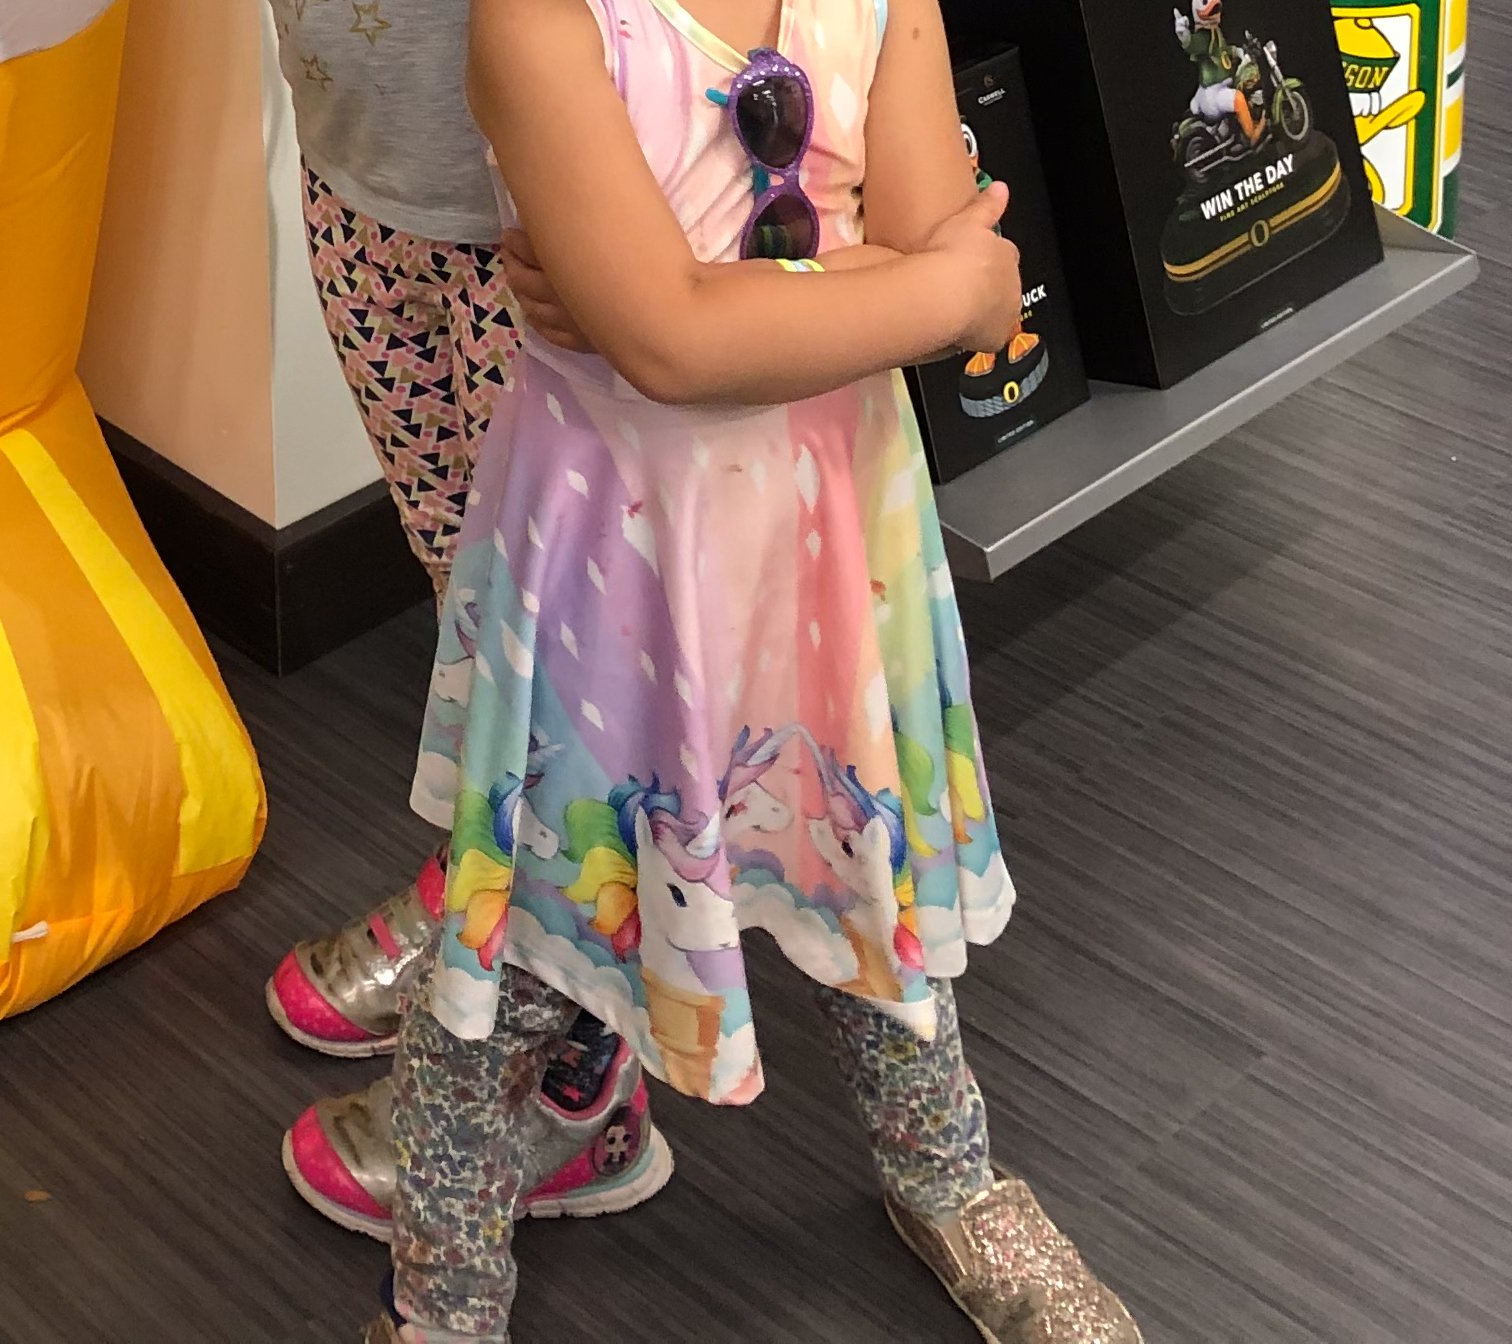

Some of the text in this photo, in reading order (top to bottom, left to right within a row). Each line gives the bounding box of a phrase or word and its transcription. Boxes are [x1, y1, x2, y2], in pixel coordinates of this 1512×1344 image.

[1342, 61, 1390, 89] GON
[1200, 153, 1294, 220] WIN THE DAY
[1021, 284, 1047, 307] UCK
